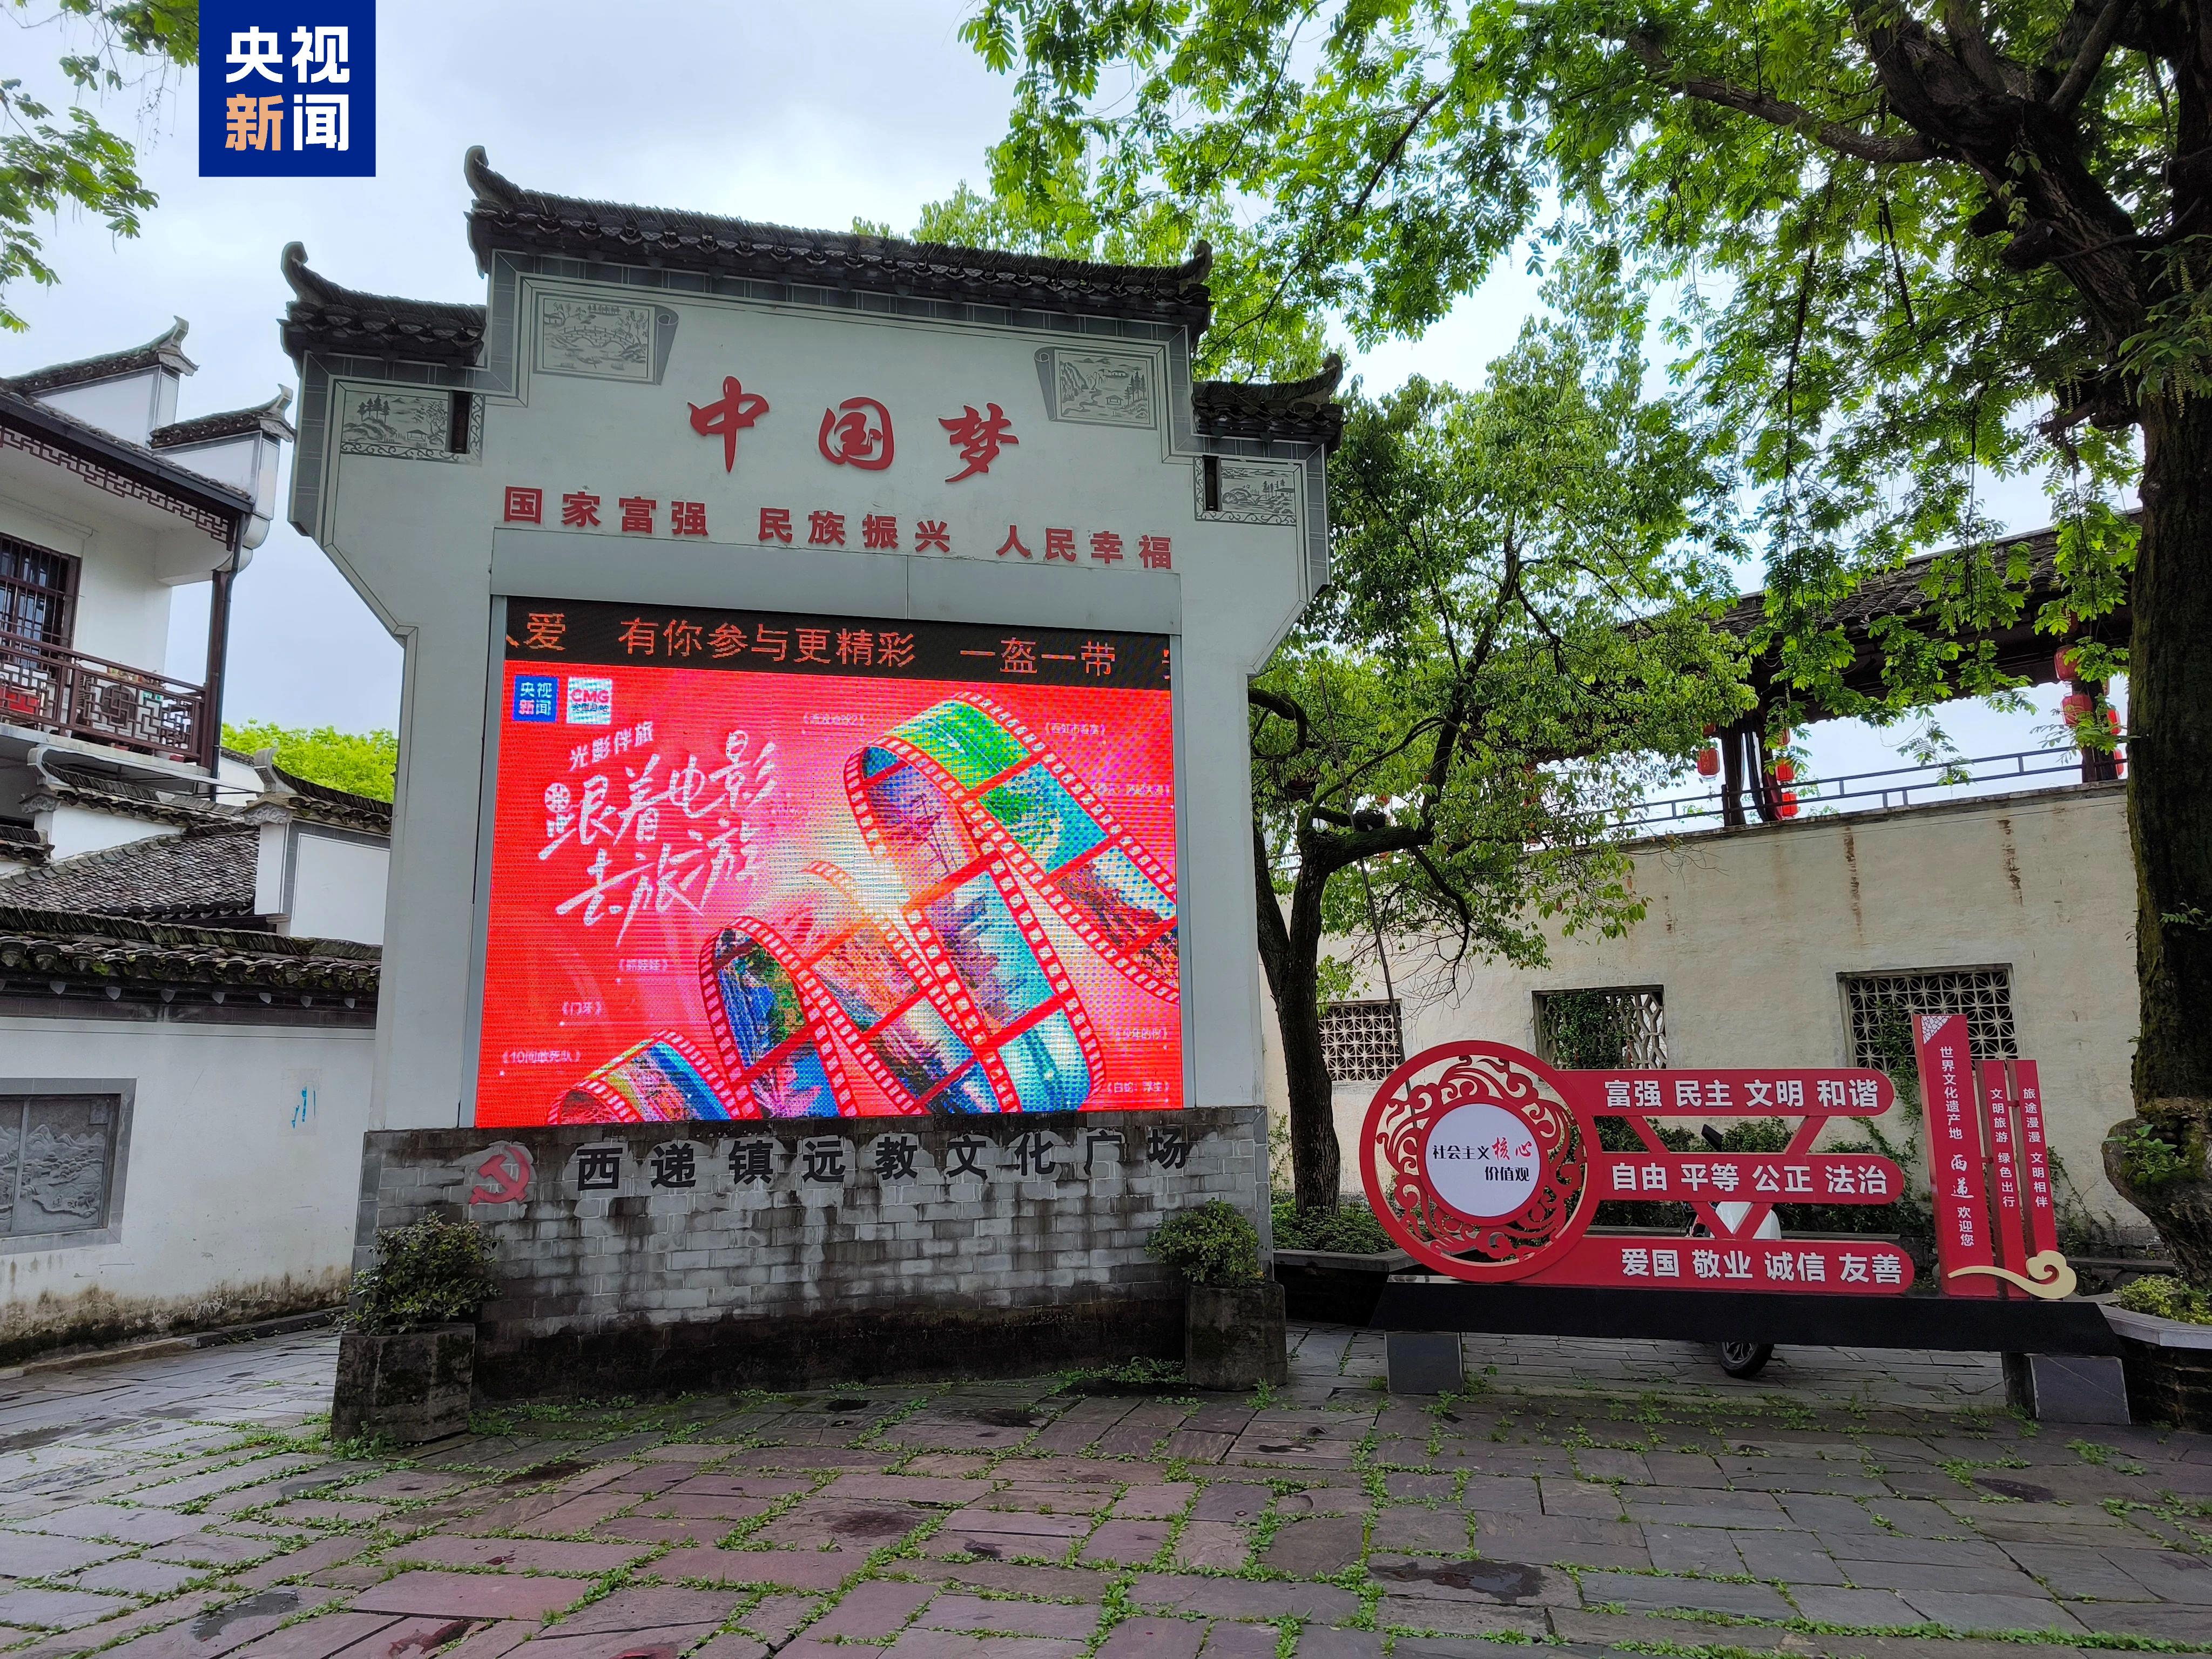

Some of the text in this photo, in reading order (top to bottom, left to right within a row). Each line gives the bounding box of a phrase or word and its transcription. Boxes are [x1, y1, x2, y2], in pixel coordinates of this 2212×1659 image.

[687, 376, 1019, 482] 中国梦
[504, 486, 1172, 569] 国家富强 民族振兴 人民幸福
[618, 617, 916, 668] 有你参与更精彩
[960, 637, 1116, 676] 一盔一带
[520, 682, 552, 698] 央视
[571, 689, 610, 703] CMG
[539, 730, 777, 860] 跟着电影
[556, 817, 757, 948] 去旅游
[1604, 1079, 1878, 1108] 富强 民主 文明 和谐
[577, 1128, 1189, 1191] 西递镇远教文化广场
[1485, 1166, 1530, 1182] 价值观
[1939, 1046, 1974, 1246] 世界文化遗产地 西递 欢迎您
[1990, 1088, 2015, 1208] 文明旅游 绿色出行
[2022, 1088, 2048, 1208] 旅途漫漫 文明相伴
[1612, 1162, 1887, 1195] 自由 平等 公正 法治
[1621, 1248, 1903, 1284] 爱国 敬业 诚信 友善
